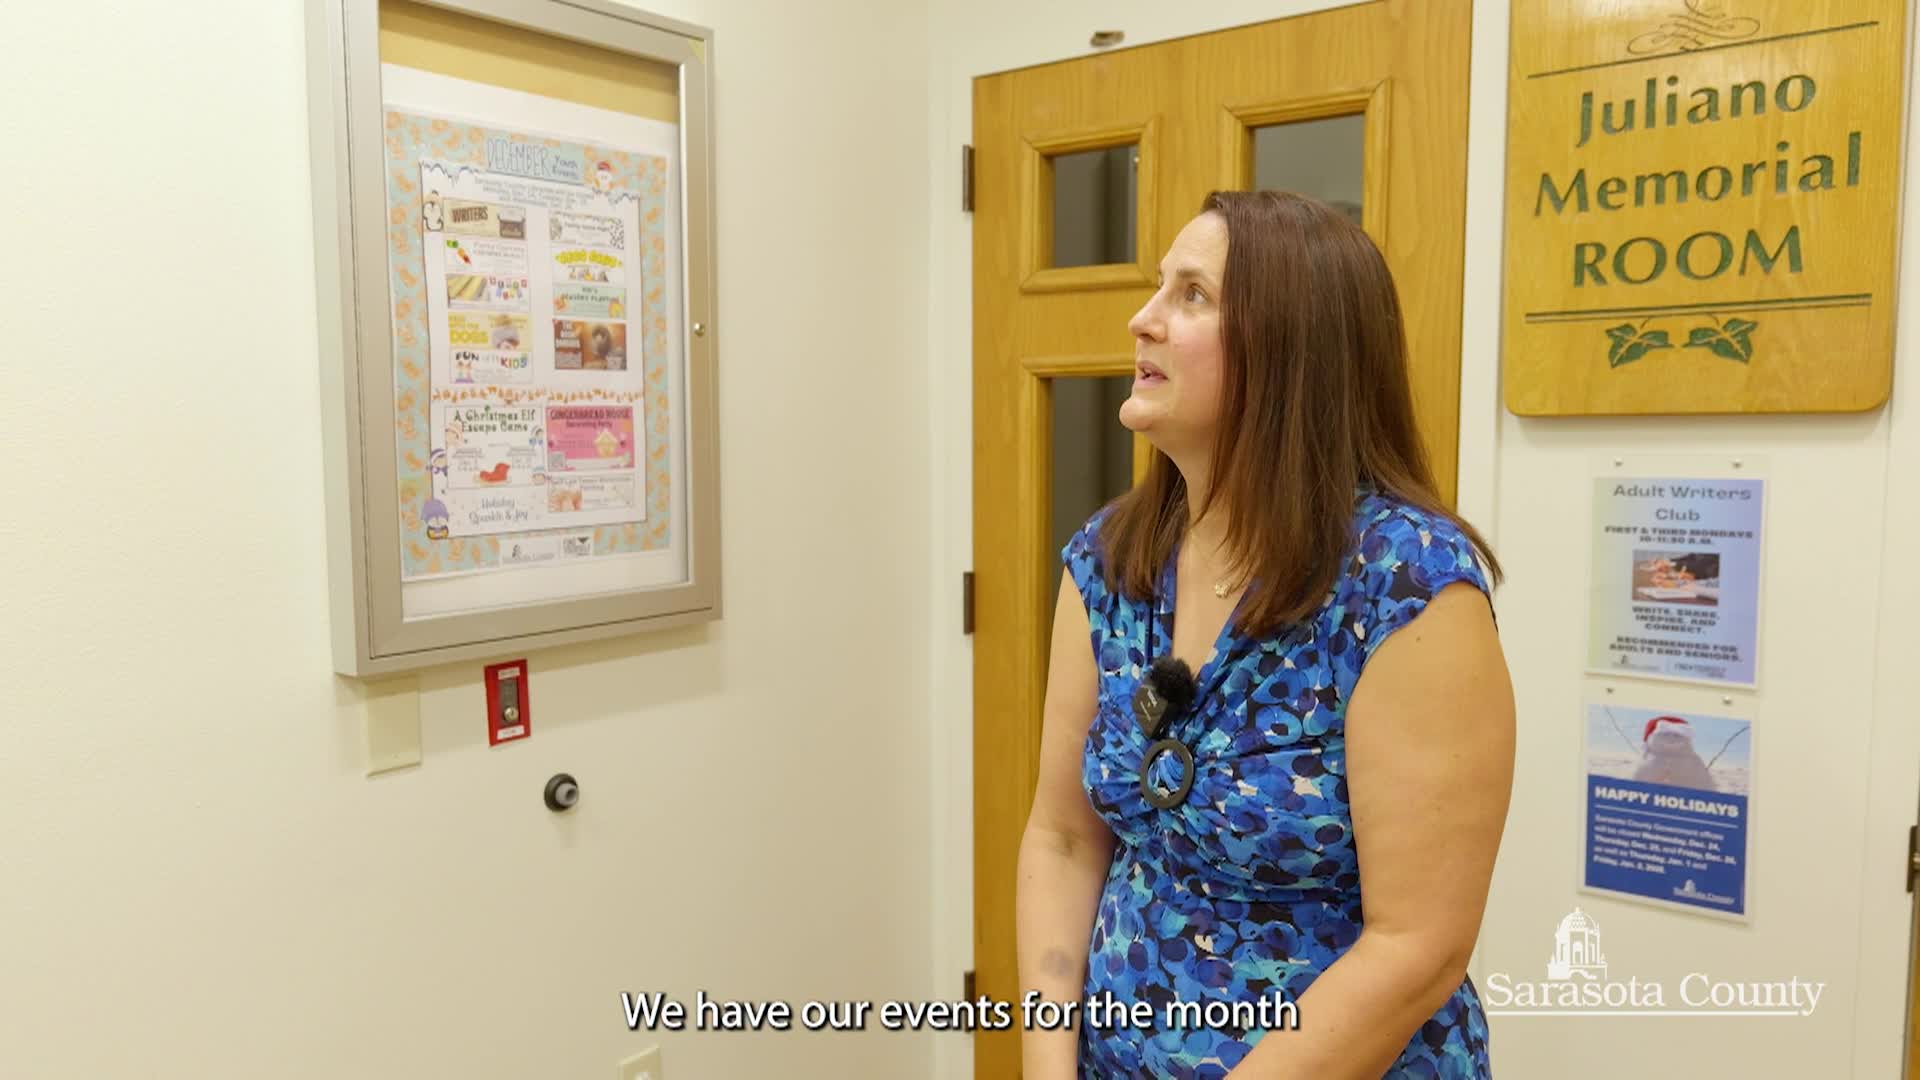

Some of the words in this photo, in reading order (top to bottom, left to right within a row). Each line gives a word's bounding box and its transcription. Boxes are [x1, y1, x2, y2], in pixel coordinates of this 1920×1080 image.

[1575, 74, 1817, 148] Juliano
[486, 138, 551, 177] DECEMBER
[1533, 131, 1862, 217] Memorial
[452, 206, 488, 224] WRITERS
[1573, 225, 1804, 288] ROOM
[455, 351, 479, 361] FUN
[454, 409, 462, 421] A
[465, 408, 518, 421] Christmas
[521, 408, 535, 421] Elf
[461, 420, 497, 435] Escape
[500, 421, 528, 433] Game
[1613, 484, 1665, 499] Adult
[1670, 486, 1752, 501] Writers
[1655, 507, 1700, 522] Club
[1605, 525, 1638, 534] FIRST
[1651, 527, 1687, 536] THIRD
[1689, 529, 1753, 539] MONDAYS
[1690, 618, 1717, 626] AND
[1609, 643, 1655, 654] ADULTS
[1656, 647, 1682, 656] AND
[1616, 635, 1710, 651] RECOMMENDED
[1713, 644, 1738, 653] FOR
[1594, 786, 1650, 805] HAPPY
[1653, 794, 1740, 817] HOLIDAYS
